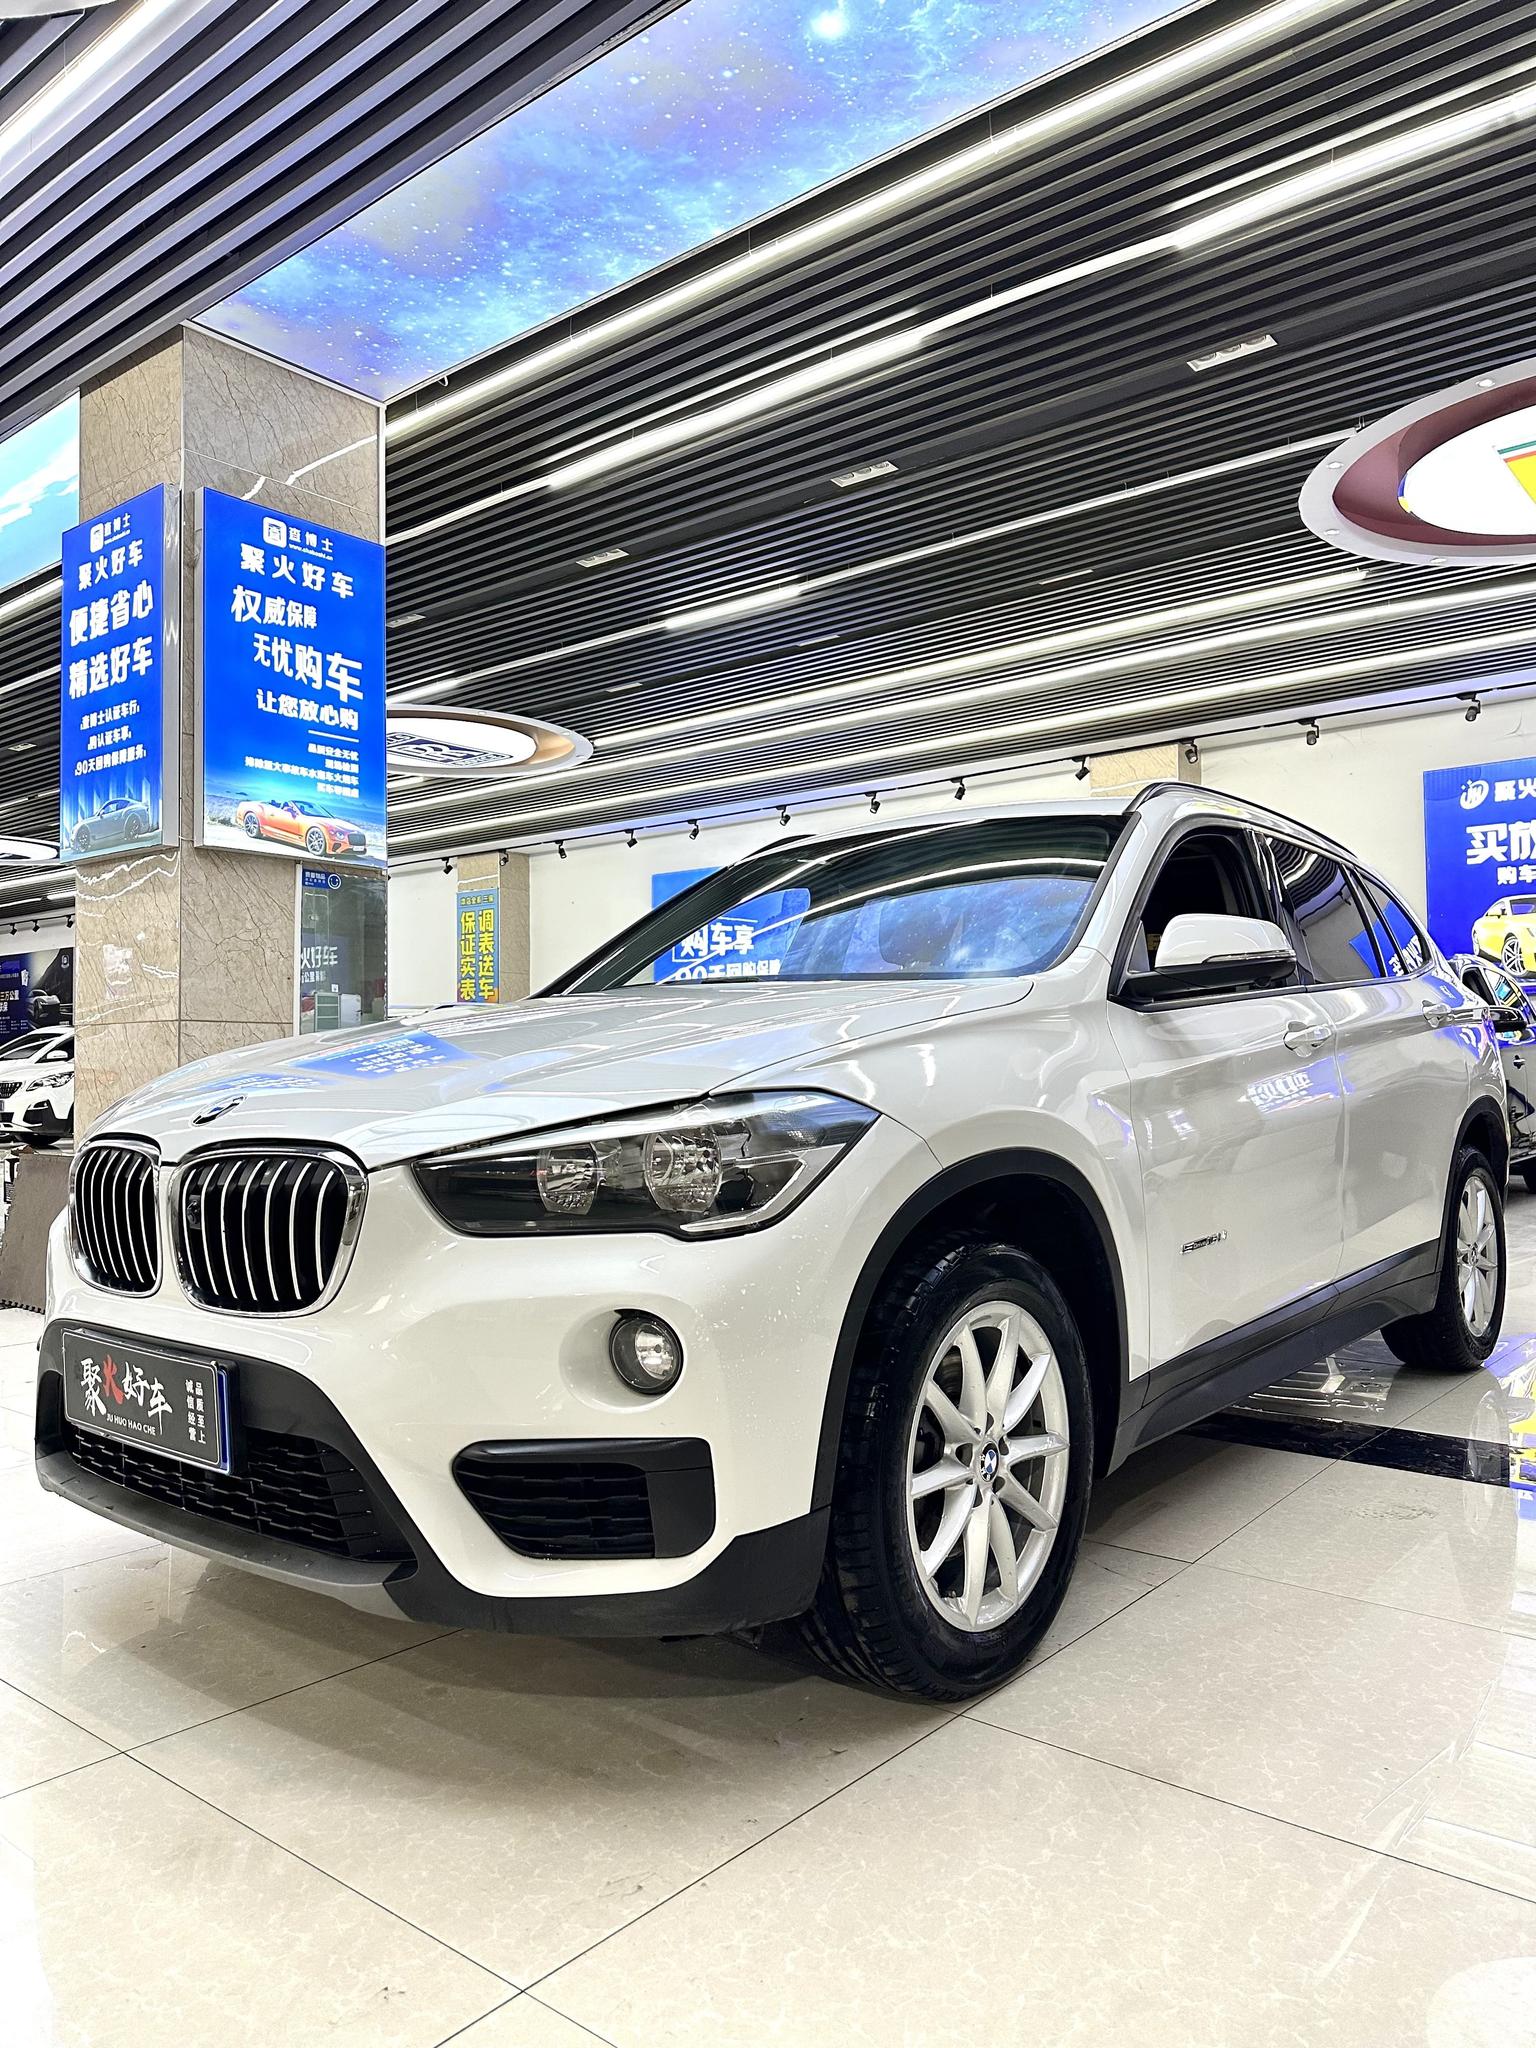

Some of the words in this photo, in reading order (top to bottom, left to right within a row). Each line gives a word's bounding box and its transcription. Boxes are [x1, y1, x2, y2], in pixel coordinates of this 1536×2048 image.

[78, 539, 144, 591] 聚火好车
[240, 543, 355, 599] 聚火好车
[288, 527, 334, 554] 查博士
[69, 579, 154, 647] 便捷省心
[230, 585, 318, 629] 权威保障
[69, 636, 153, 700] 精选好车
[253, 632, 364, 703] 无忧购车
[256, 688, 359, 731] 让您放心购
[460, 911, 477, 1001] 保证实表
[478, 908, 495, 1000] 调表送车
[80, 1354, 173, 1436] 聚火好车
[113, 1414, 128, 1427] HUO
[127, 1419, 143, 1431] HAO
[142, 1424, 156, 1436] CHE
[195, 1381, 207, 1445] 品质至上
